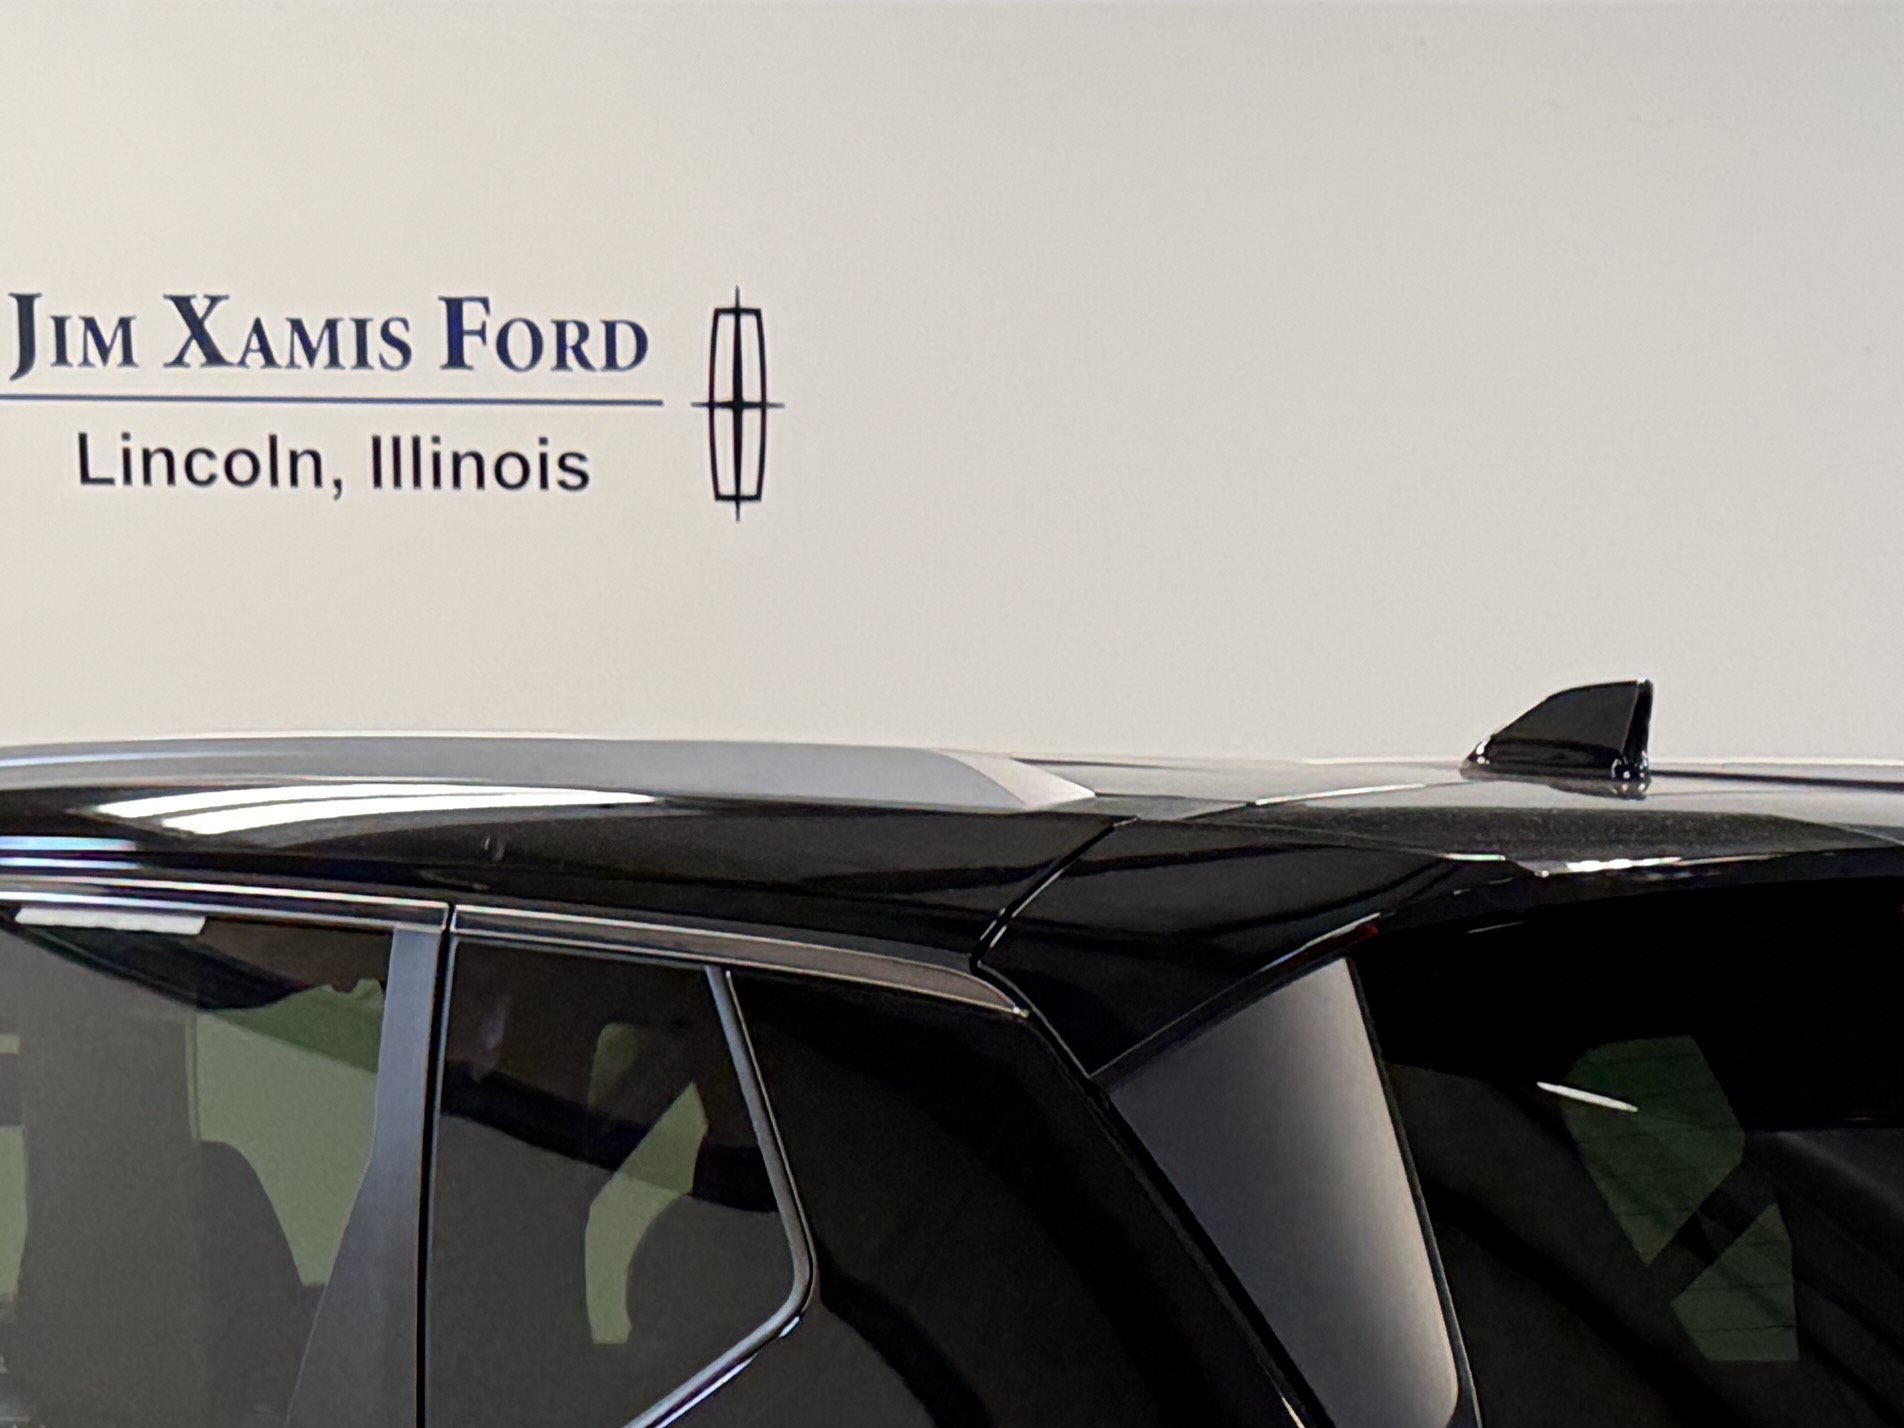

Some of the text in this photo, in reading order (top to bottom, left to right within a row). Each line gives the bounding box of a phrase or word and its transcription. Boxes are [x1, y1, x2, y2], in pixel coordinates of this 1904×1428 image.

[7, 292, 650, 381] JIM XAMIS FORD
[77, 430, 591, 502] Lincoln, Illinois
